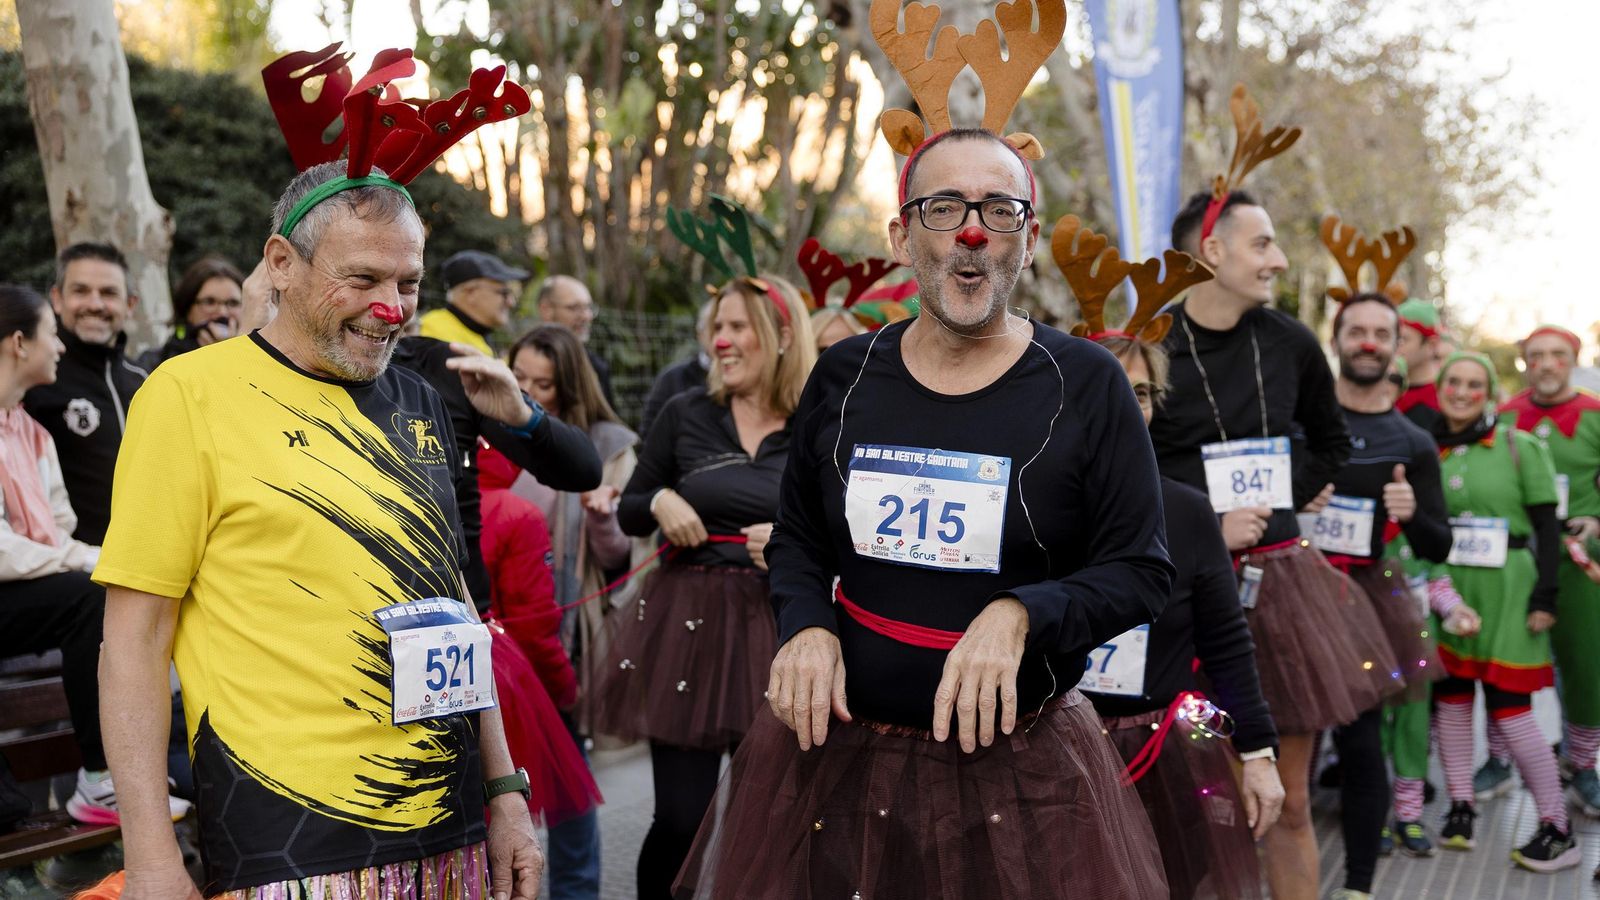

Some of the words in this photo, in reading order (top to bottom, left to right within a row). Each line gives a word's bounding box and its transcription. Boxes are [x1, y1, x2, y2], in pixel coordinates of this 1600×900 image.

[865, 448, 881, 459] SAN
[882, 449, 926, 463] SILVESTRE
[927, 455, 969, 469] GADITANA
[1231, 468, 1273, 494] 847
[876, 494, 966, 544] 215
[389, 606, 407, 618] SAN
[406, 603, 442, 615] SILVESTRE
[426, 643, 474, 691] 521
